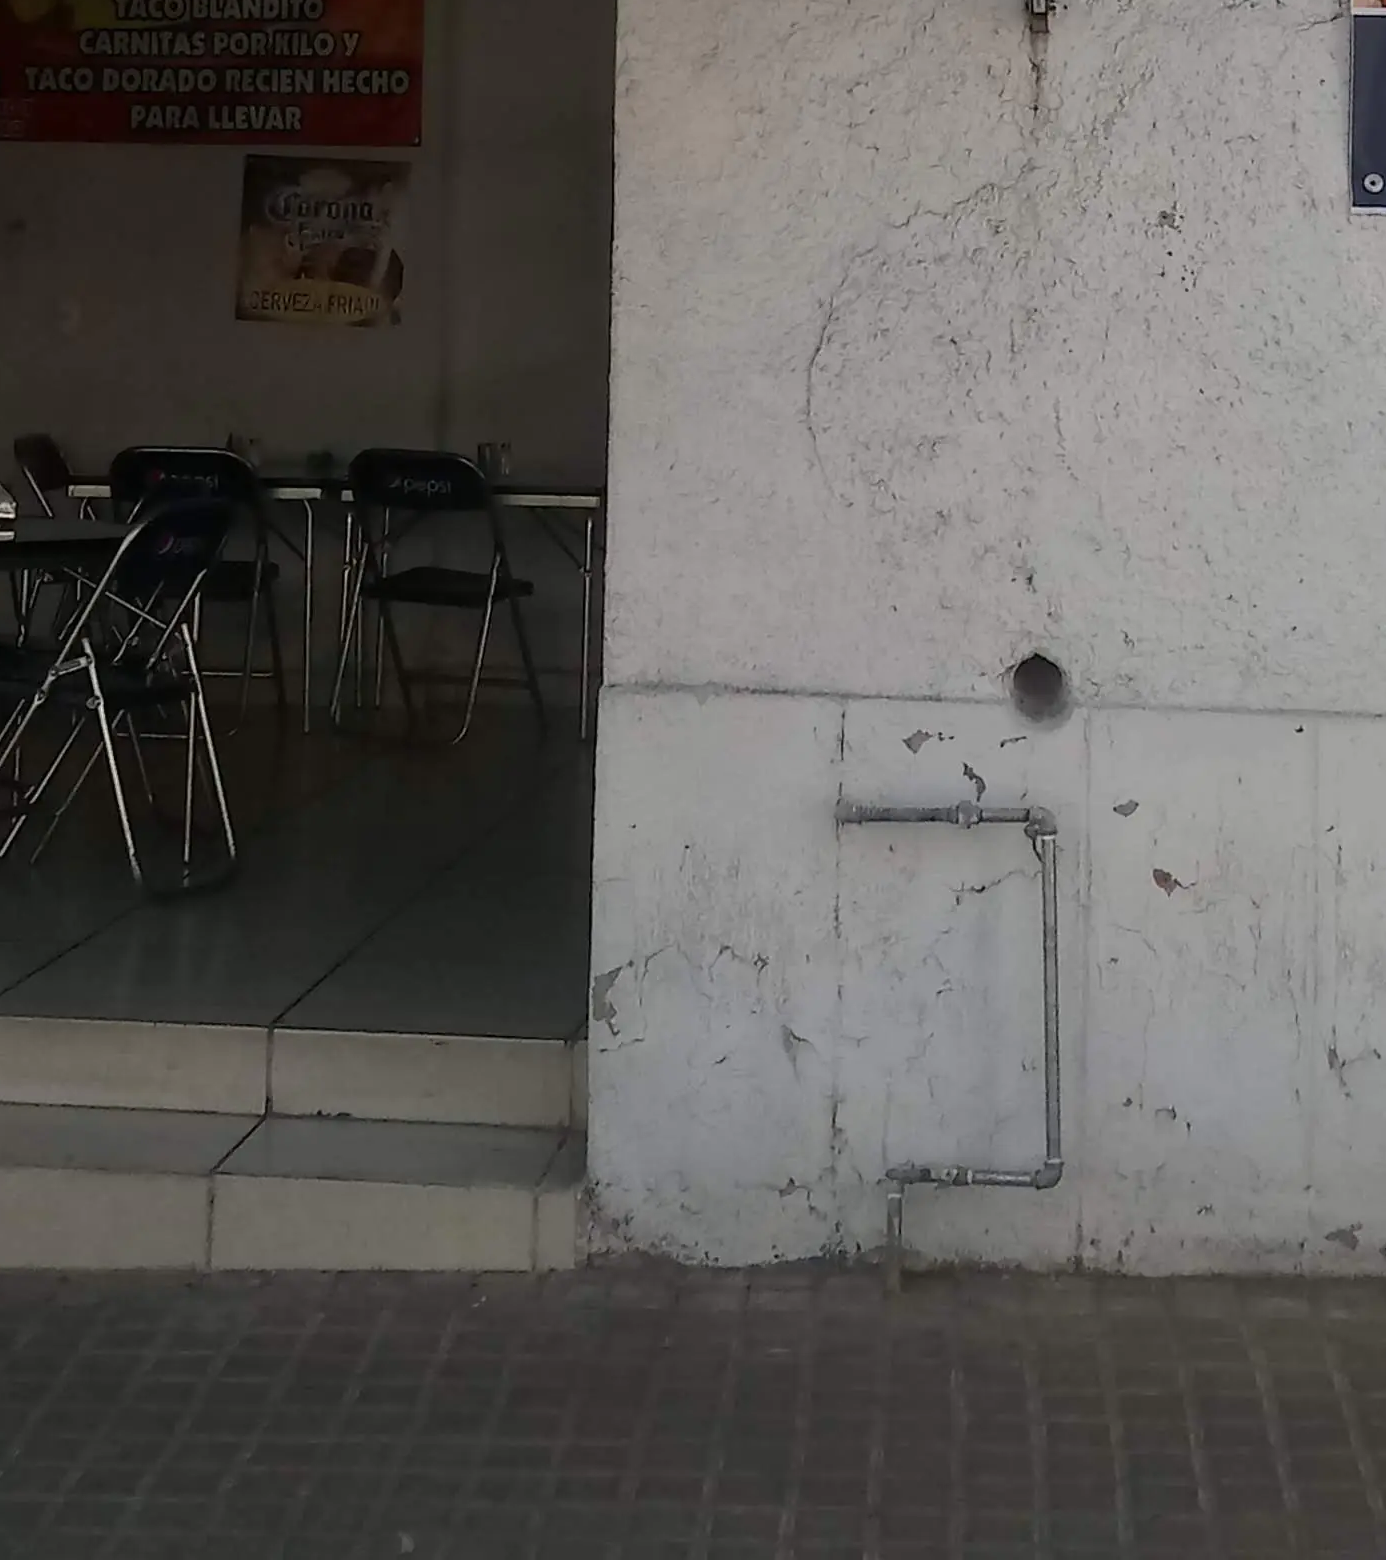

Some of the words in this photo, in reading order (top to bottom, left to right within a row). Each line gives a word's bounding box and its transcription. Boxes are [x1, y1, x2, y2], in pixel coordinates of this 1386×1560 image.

[79, 29, 206, 56] CARNITAS
[212, 30, 270, 57] POR
[272, 30, 335, 57] KILO
[25, 66, 93, 93] TACO
[101, 66, 218, 95] DORADO
[225, 67, 315, 95] RECIEN
[322, 68, 410, 96] HECHO
[129, 104, 202, 131] PARA
[208, 103, 302, 131] LLEVAR
